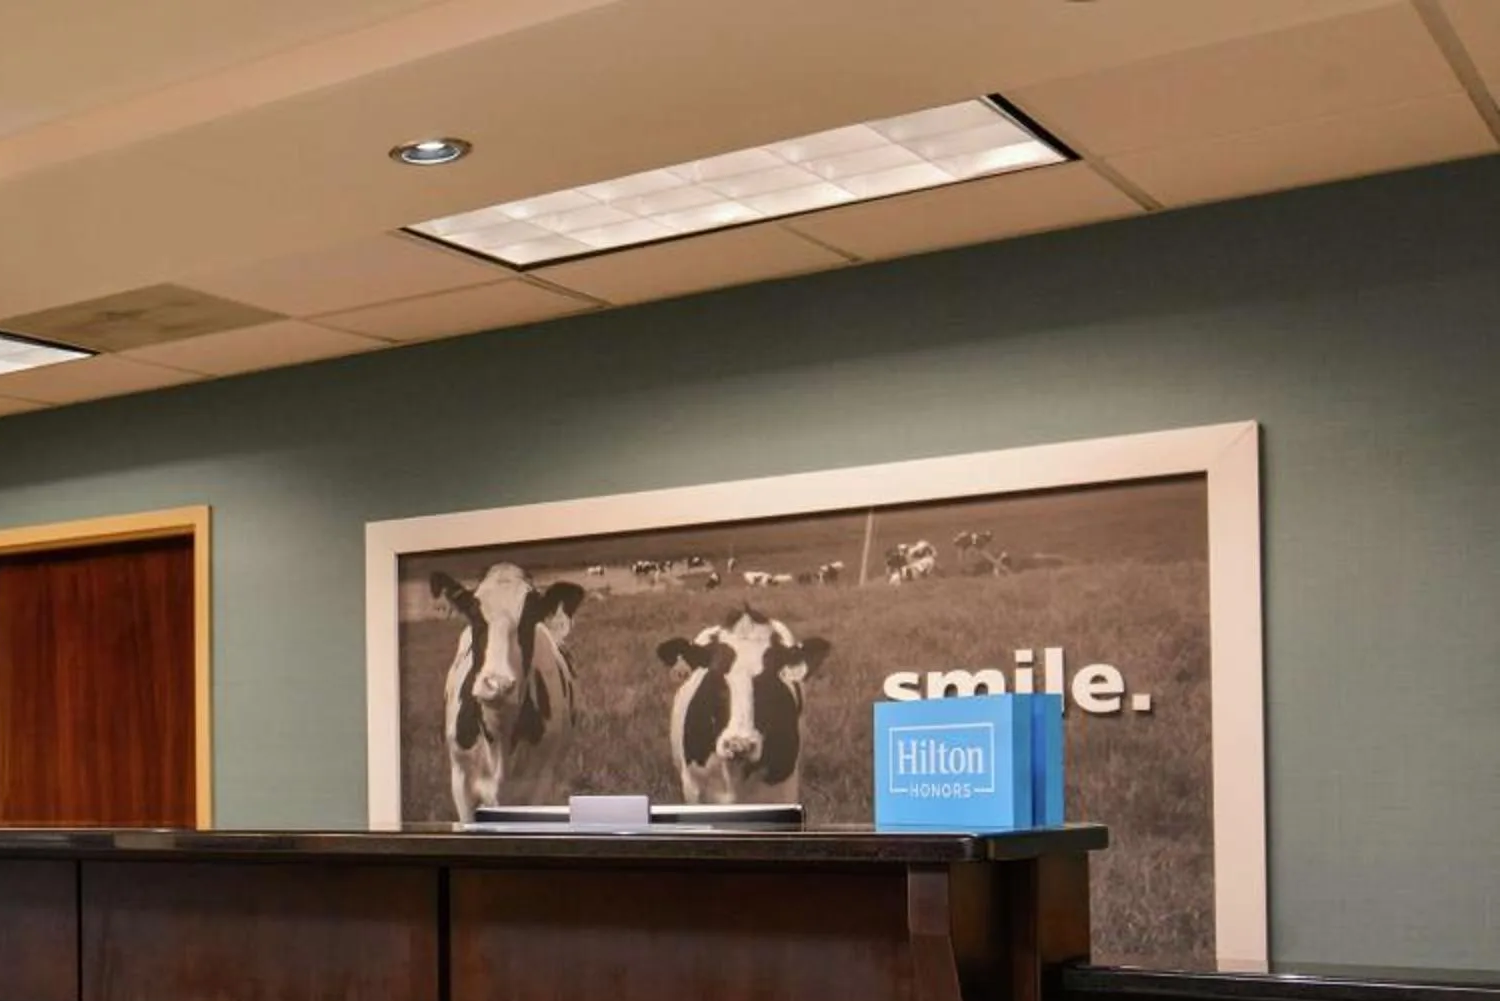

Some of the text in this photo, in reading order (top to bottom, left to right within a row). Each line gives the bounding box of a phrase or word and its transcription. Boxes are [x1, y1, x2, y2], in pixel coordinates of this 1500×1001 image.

[882, 647, 1152, 713] smile.
[897, 738, 985, 776] Hilton
[909, 783, 972, 799] HONORS
